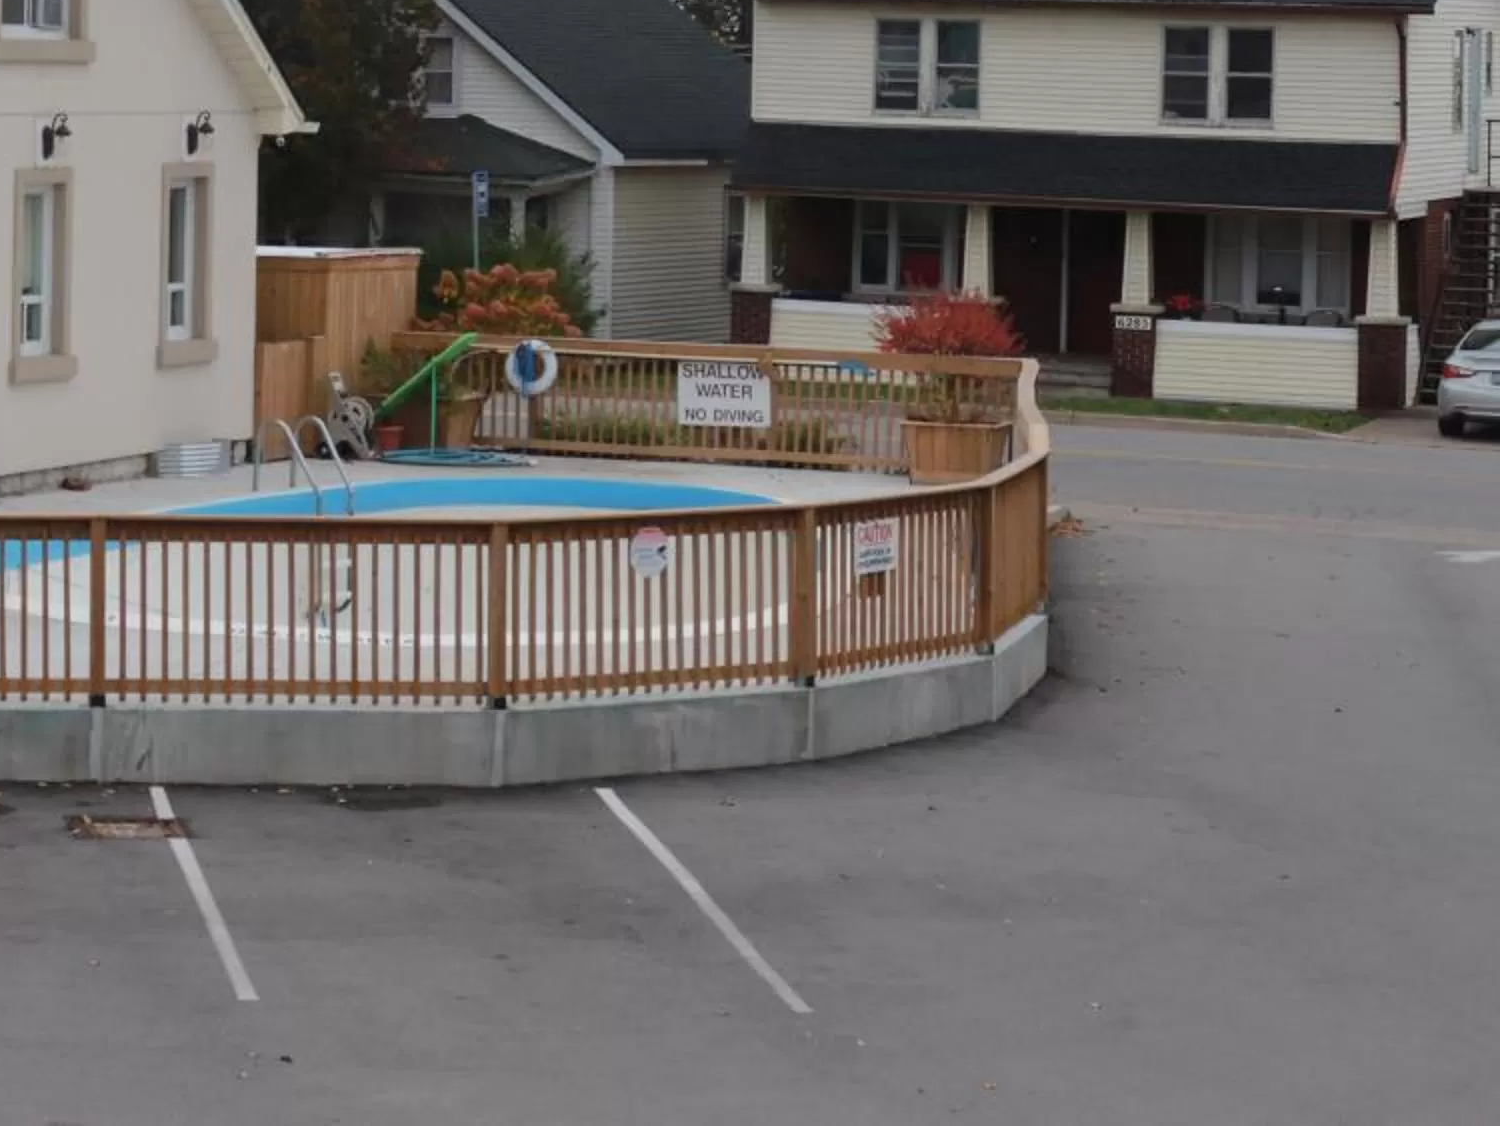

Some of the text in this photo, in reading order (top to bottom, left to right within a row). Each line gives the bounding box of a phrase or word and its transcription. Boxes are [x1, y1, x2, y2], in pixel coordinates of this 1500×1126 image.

[682, 362, 764, 380] SHALLOW
[695, 382, 753, 400] WATER
[684, 407, 765, 423] NO DIVING
[858, 524, 893, 543] CAUTION
